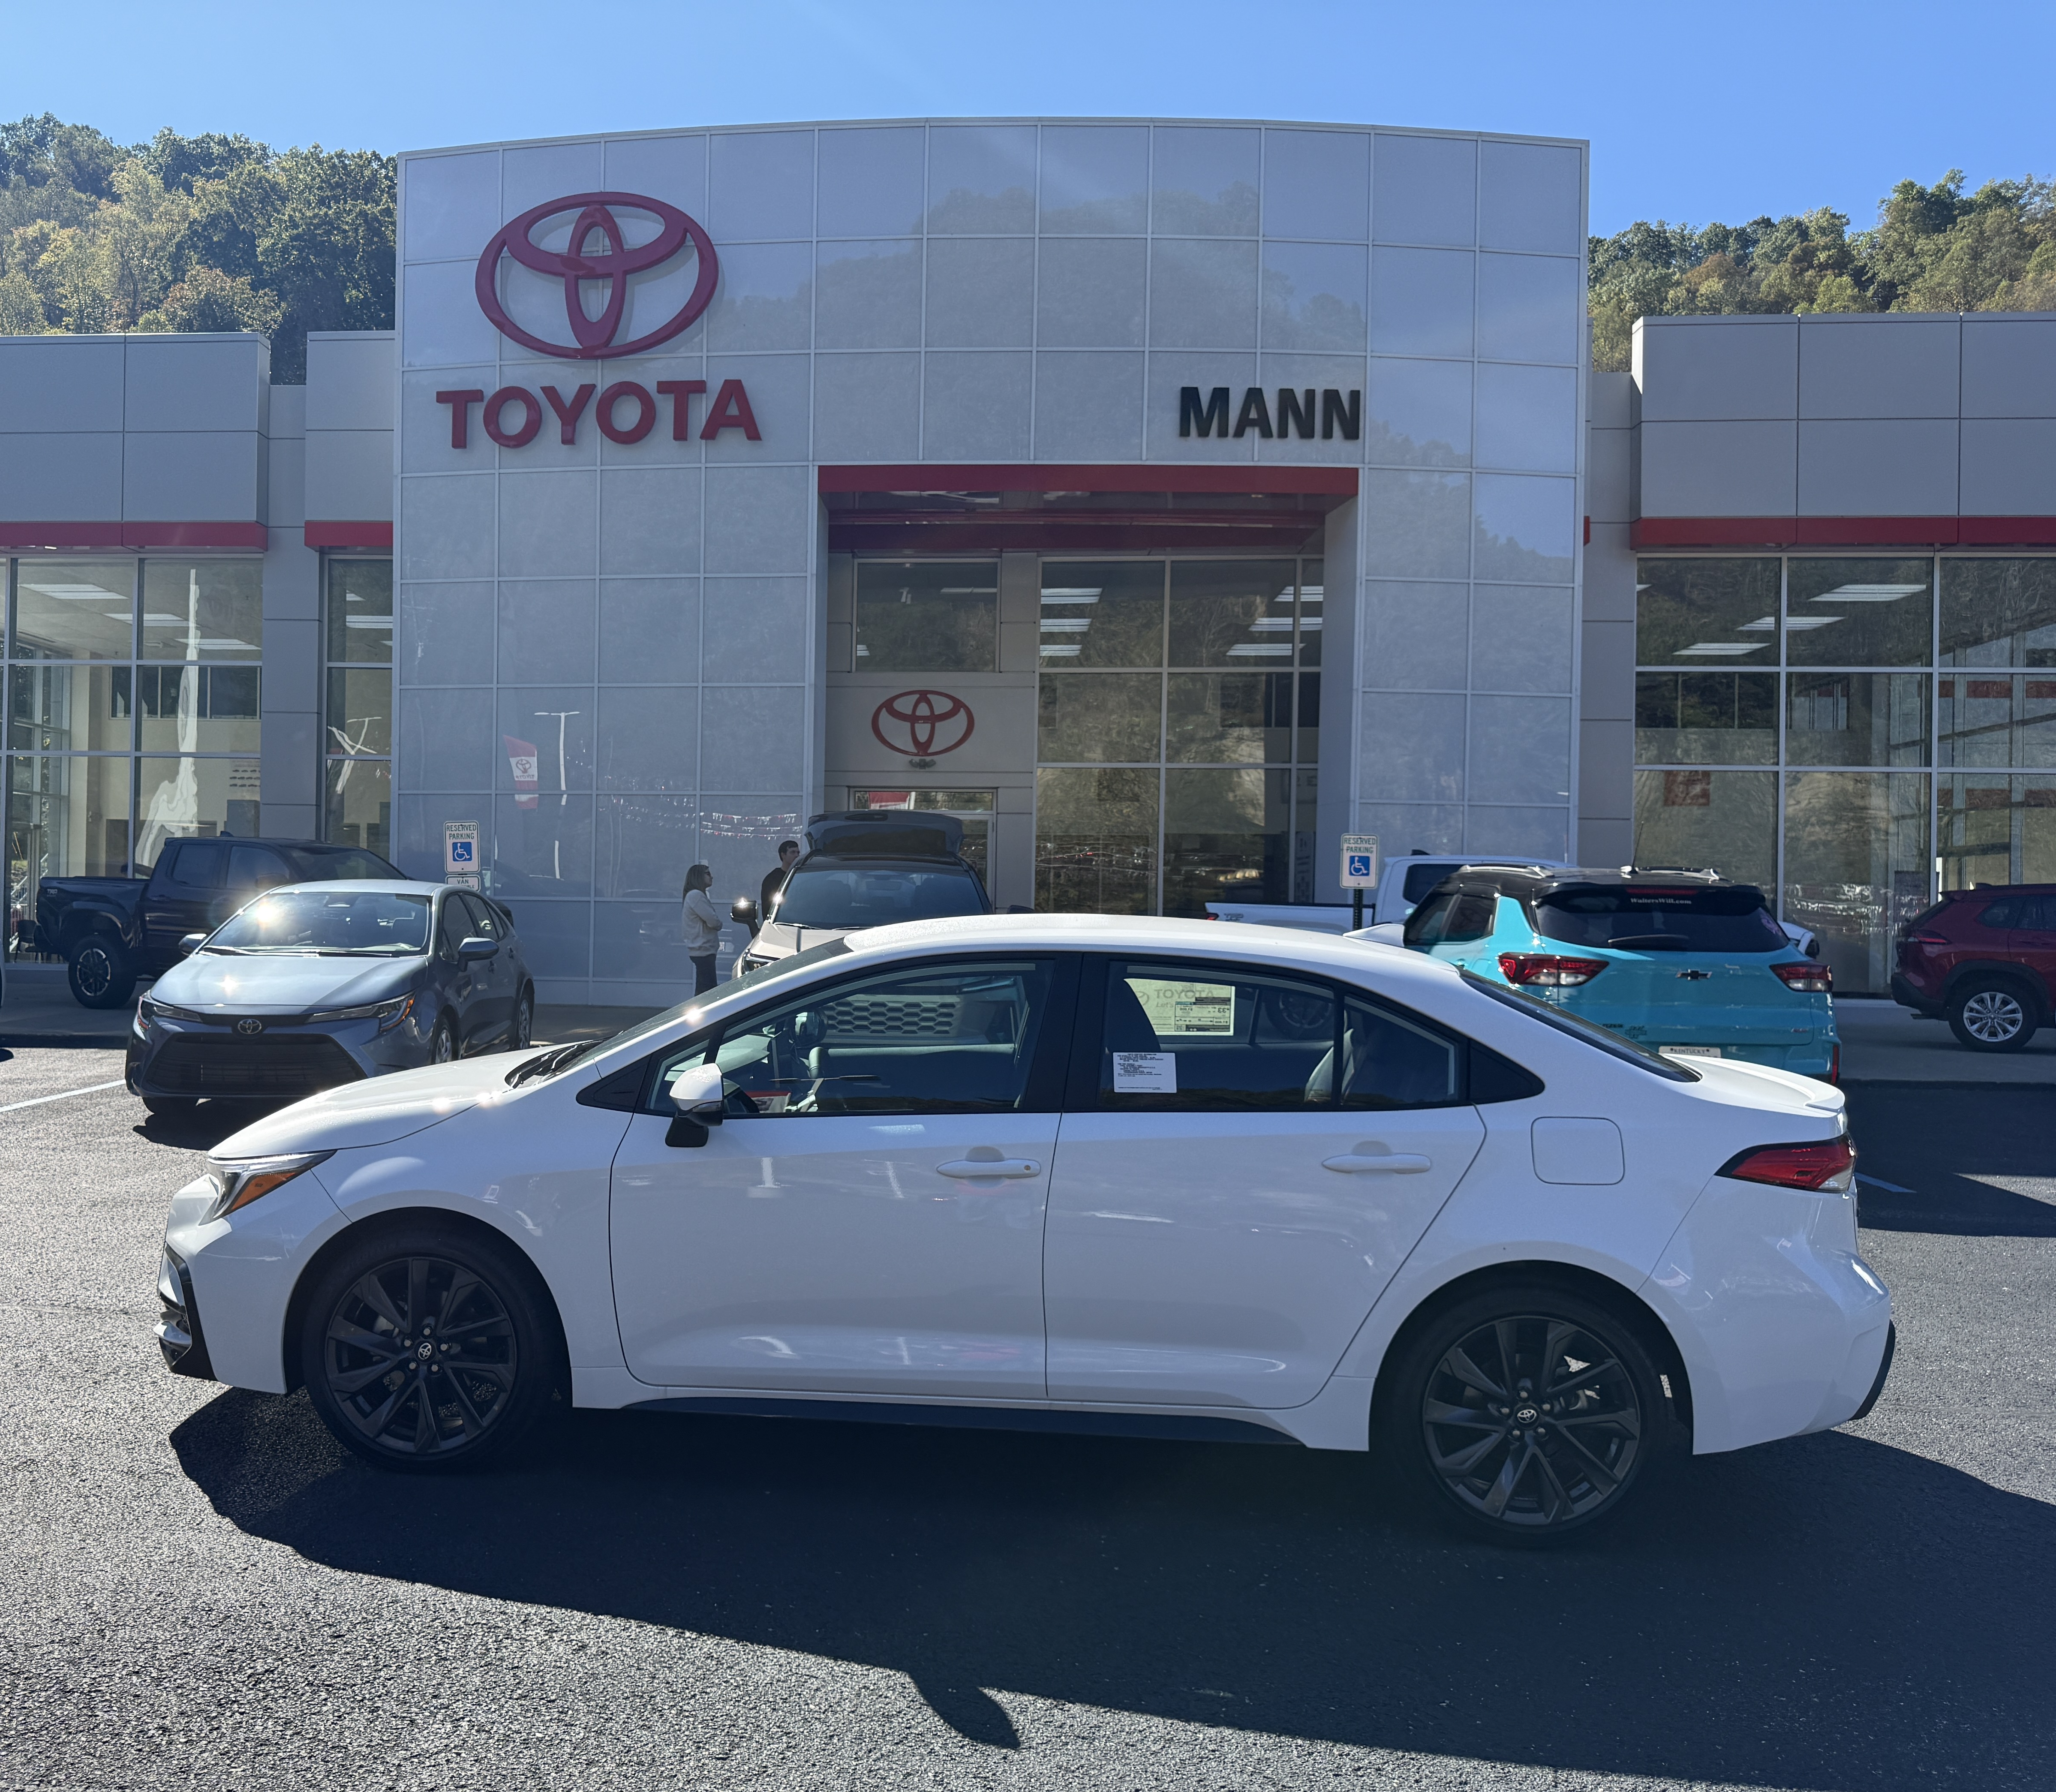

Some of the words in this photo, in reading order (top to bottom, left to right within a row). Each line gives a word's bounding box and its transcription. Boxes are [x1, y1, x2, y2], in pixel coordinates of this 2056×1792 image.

[436, 379, 762, 449] TOYOTA
[1179, 387, 1360, 440] MANN
[1154, 989, 1214, 999] TOYOTA
